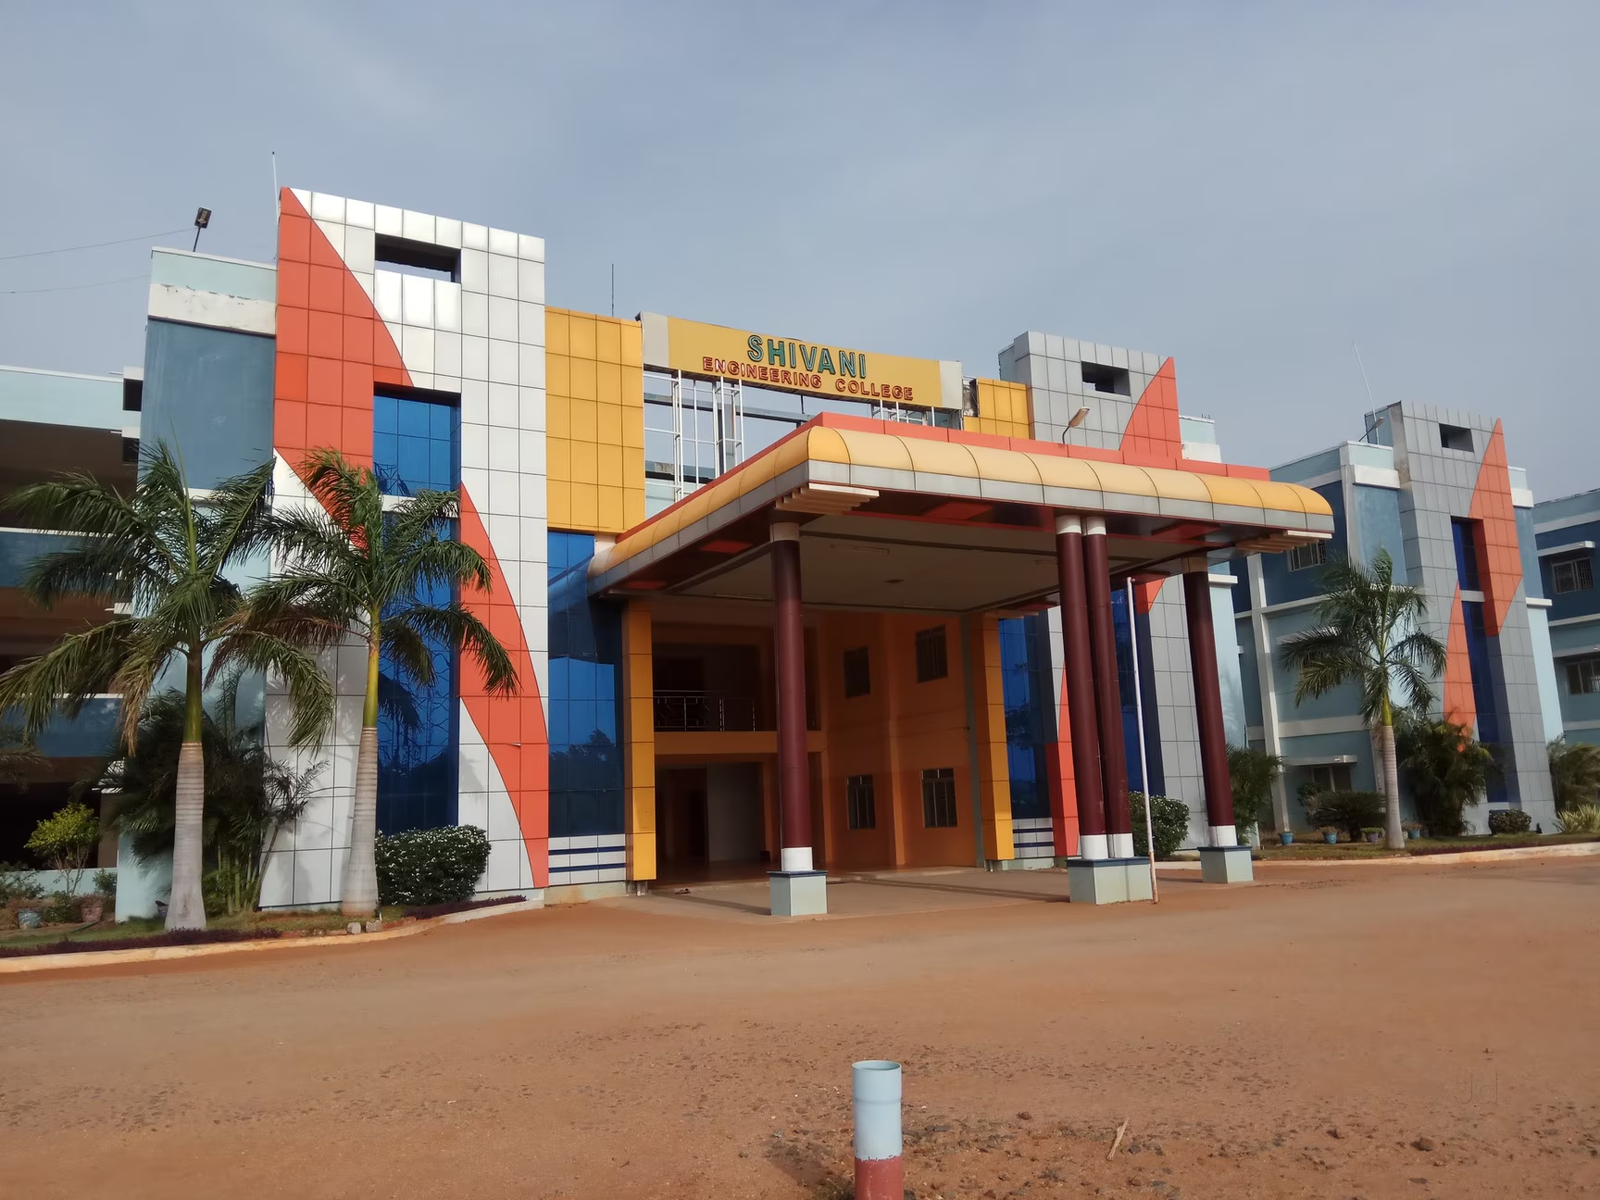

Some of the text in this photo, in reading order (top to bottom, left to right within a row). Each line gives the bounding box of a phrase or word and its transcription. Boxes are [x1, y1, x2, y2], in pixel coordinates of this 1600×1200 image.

[702, 356, 914, 401] ENGINEERING COLLEGE
[747, 334, 867, 379] SHIVANI
